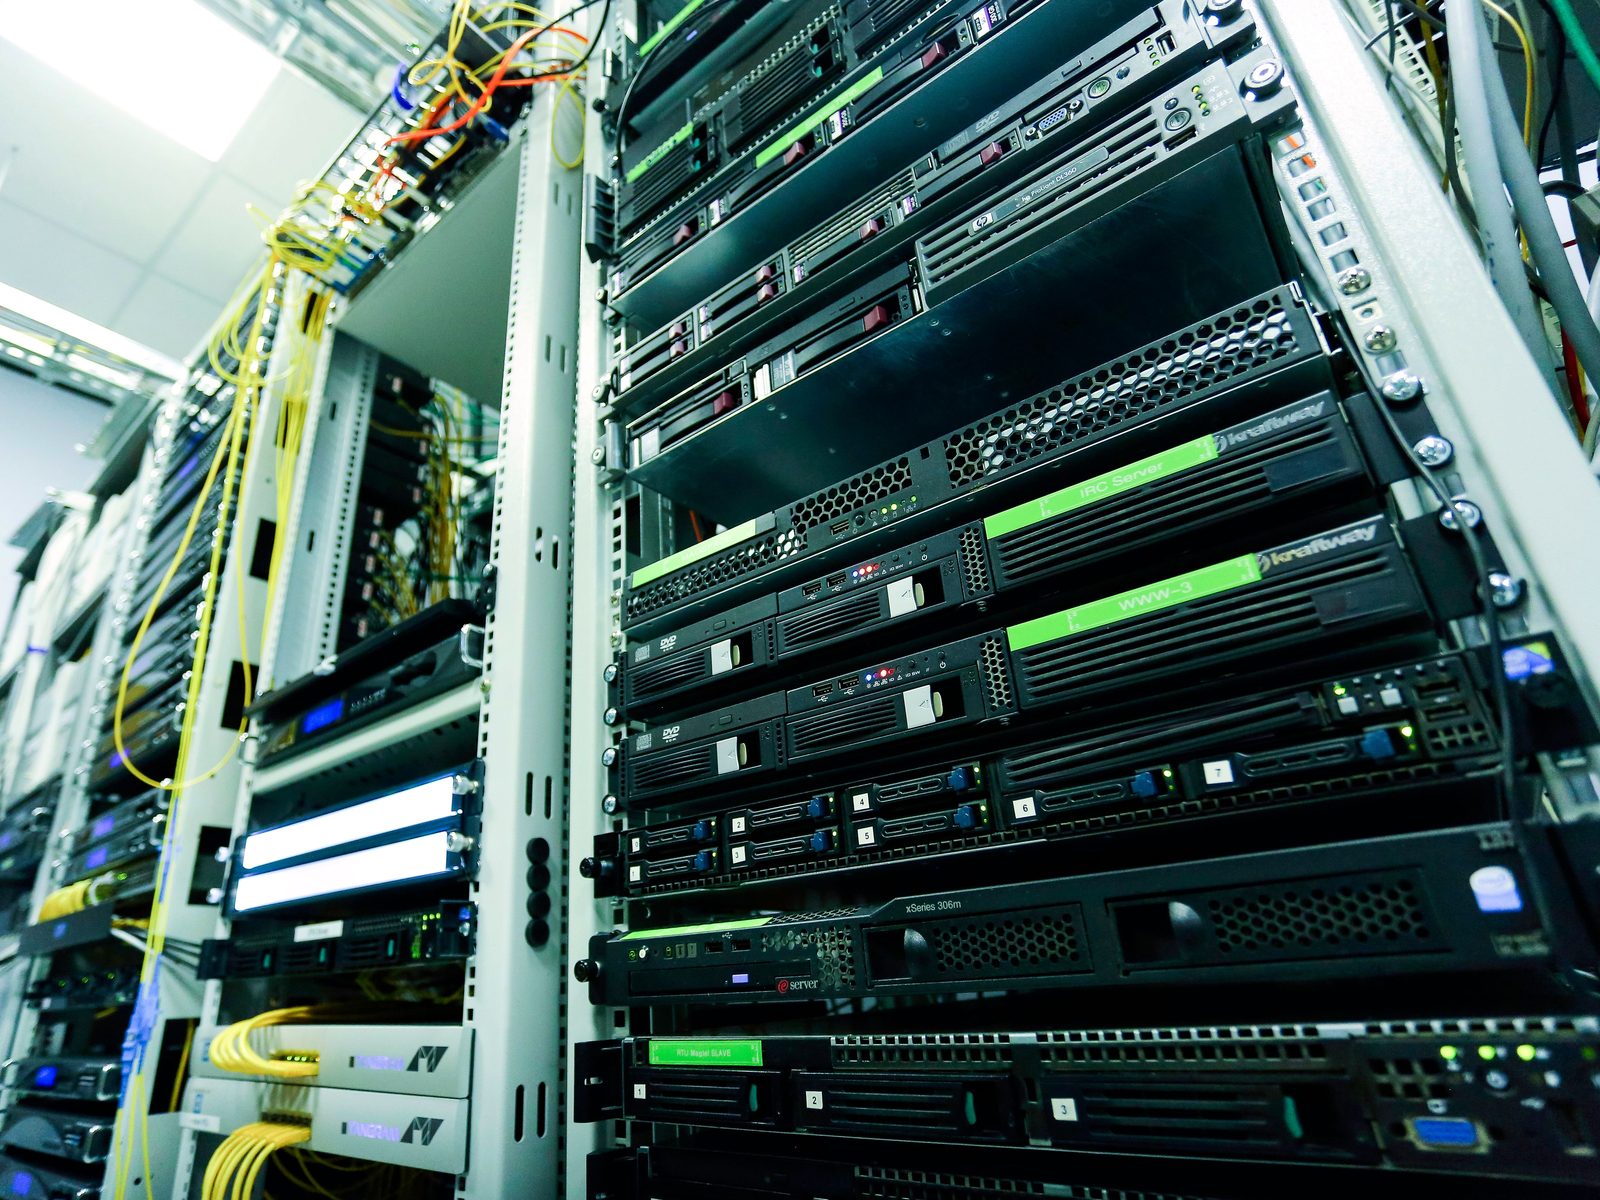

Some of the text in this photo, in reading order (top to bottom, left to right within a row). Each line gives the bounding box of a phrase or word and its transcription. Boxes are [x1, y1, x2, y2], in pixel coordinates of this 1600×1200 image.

[1228, 401, 1325, 446] kraftway
[1079, 461, 1164, 500] IRC Server
[1270, 523, 1377, 566] kraftway
[660, 635, 677, 646] DVD
[663, 725, 680, 737] DVD
[905, 900, 962, 914] xSeries 306m
